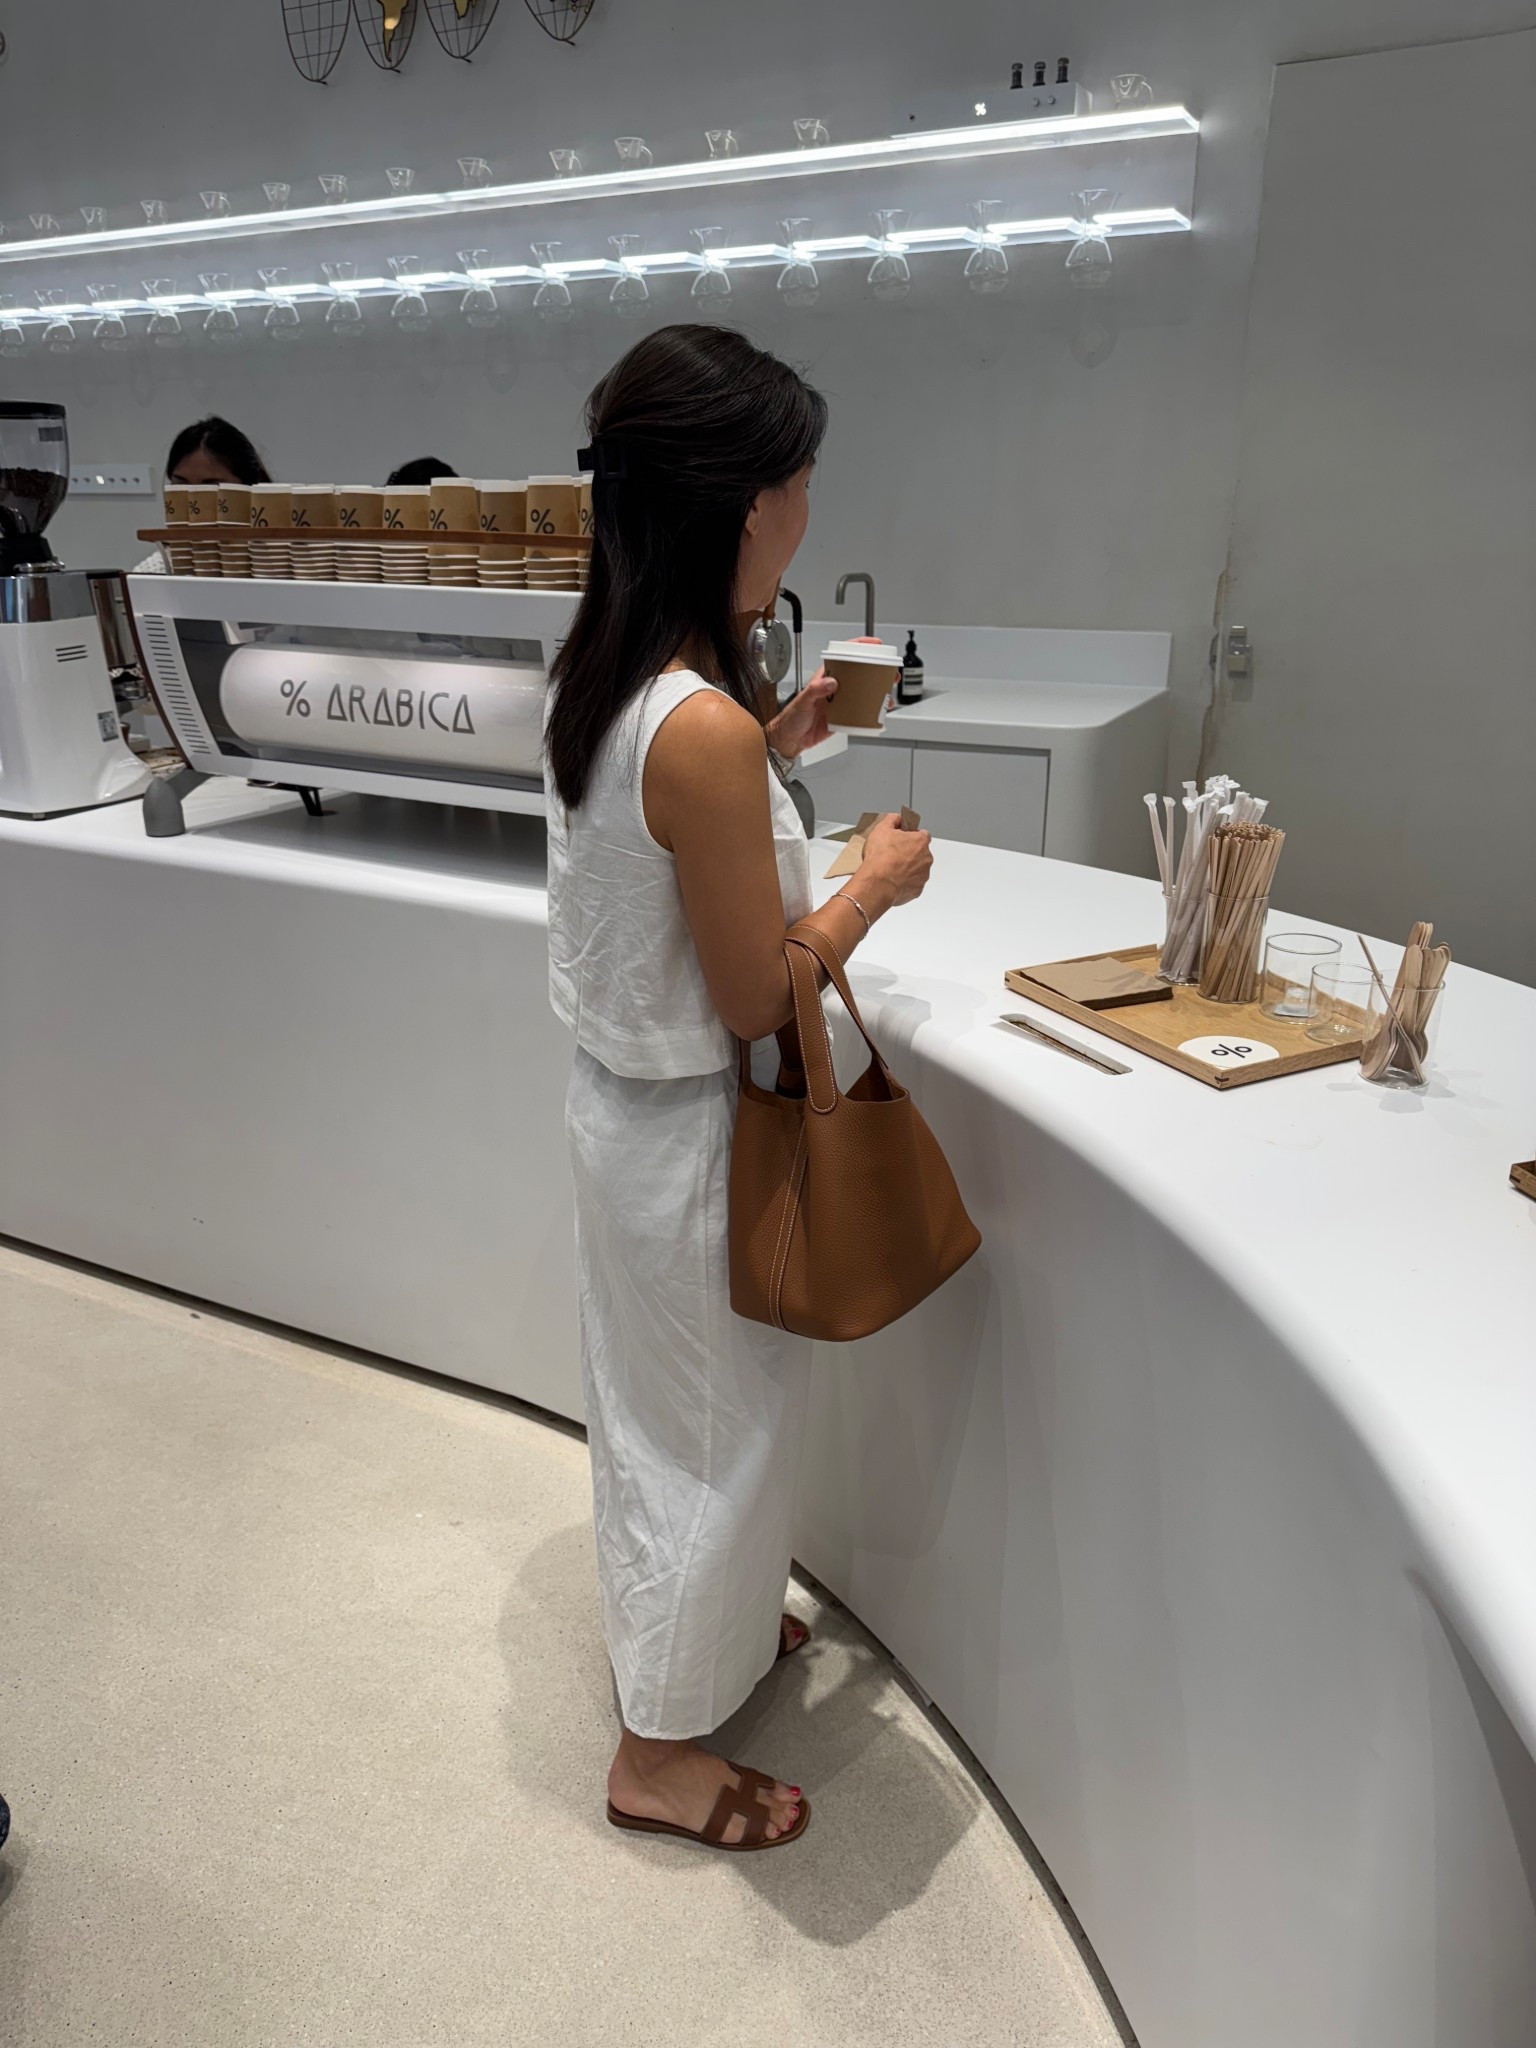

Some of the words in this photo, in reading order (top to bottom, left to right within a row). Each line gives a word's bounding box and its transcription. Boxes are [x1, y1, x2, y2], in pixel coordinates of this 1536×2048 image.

[251, 506, 269, 528] %
[340, 508, 361, 528] %
[384, 508, 404, 529] %
[429, 508, 448, 530] %
[530, 508, 556, 534] %
[280, 679, 311, 718] %
[327, 683, 476, 735] ARABICA
